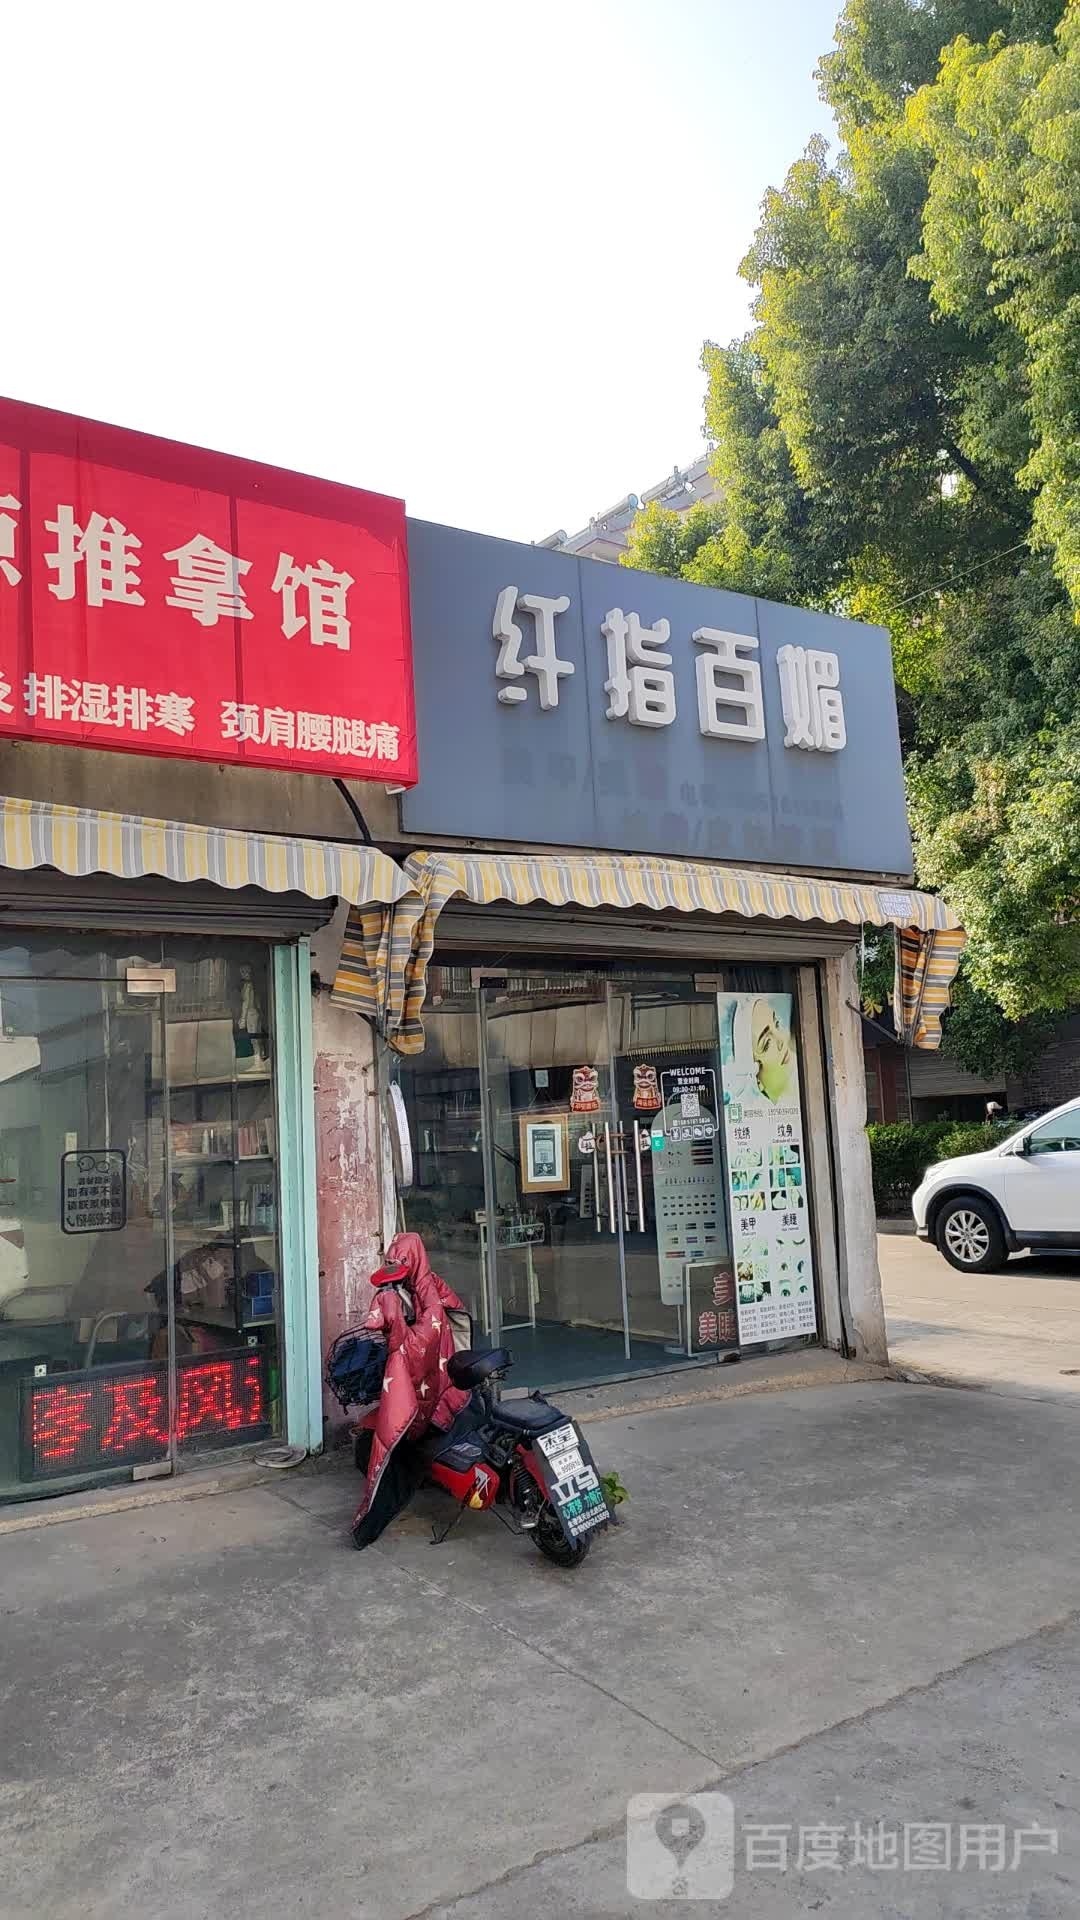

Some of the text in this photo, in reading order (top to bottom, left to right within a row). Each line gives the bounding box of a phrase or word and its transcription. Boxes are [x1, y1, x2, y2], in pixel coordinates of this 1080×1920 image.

[493, 585, 847, 753] 纤指百媚
[219, 700, 400, 761] 颈肩腰腿痛
[670, 1067, 706, 1076] WELCOME
